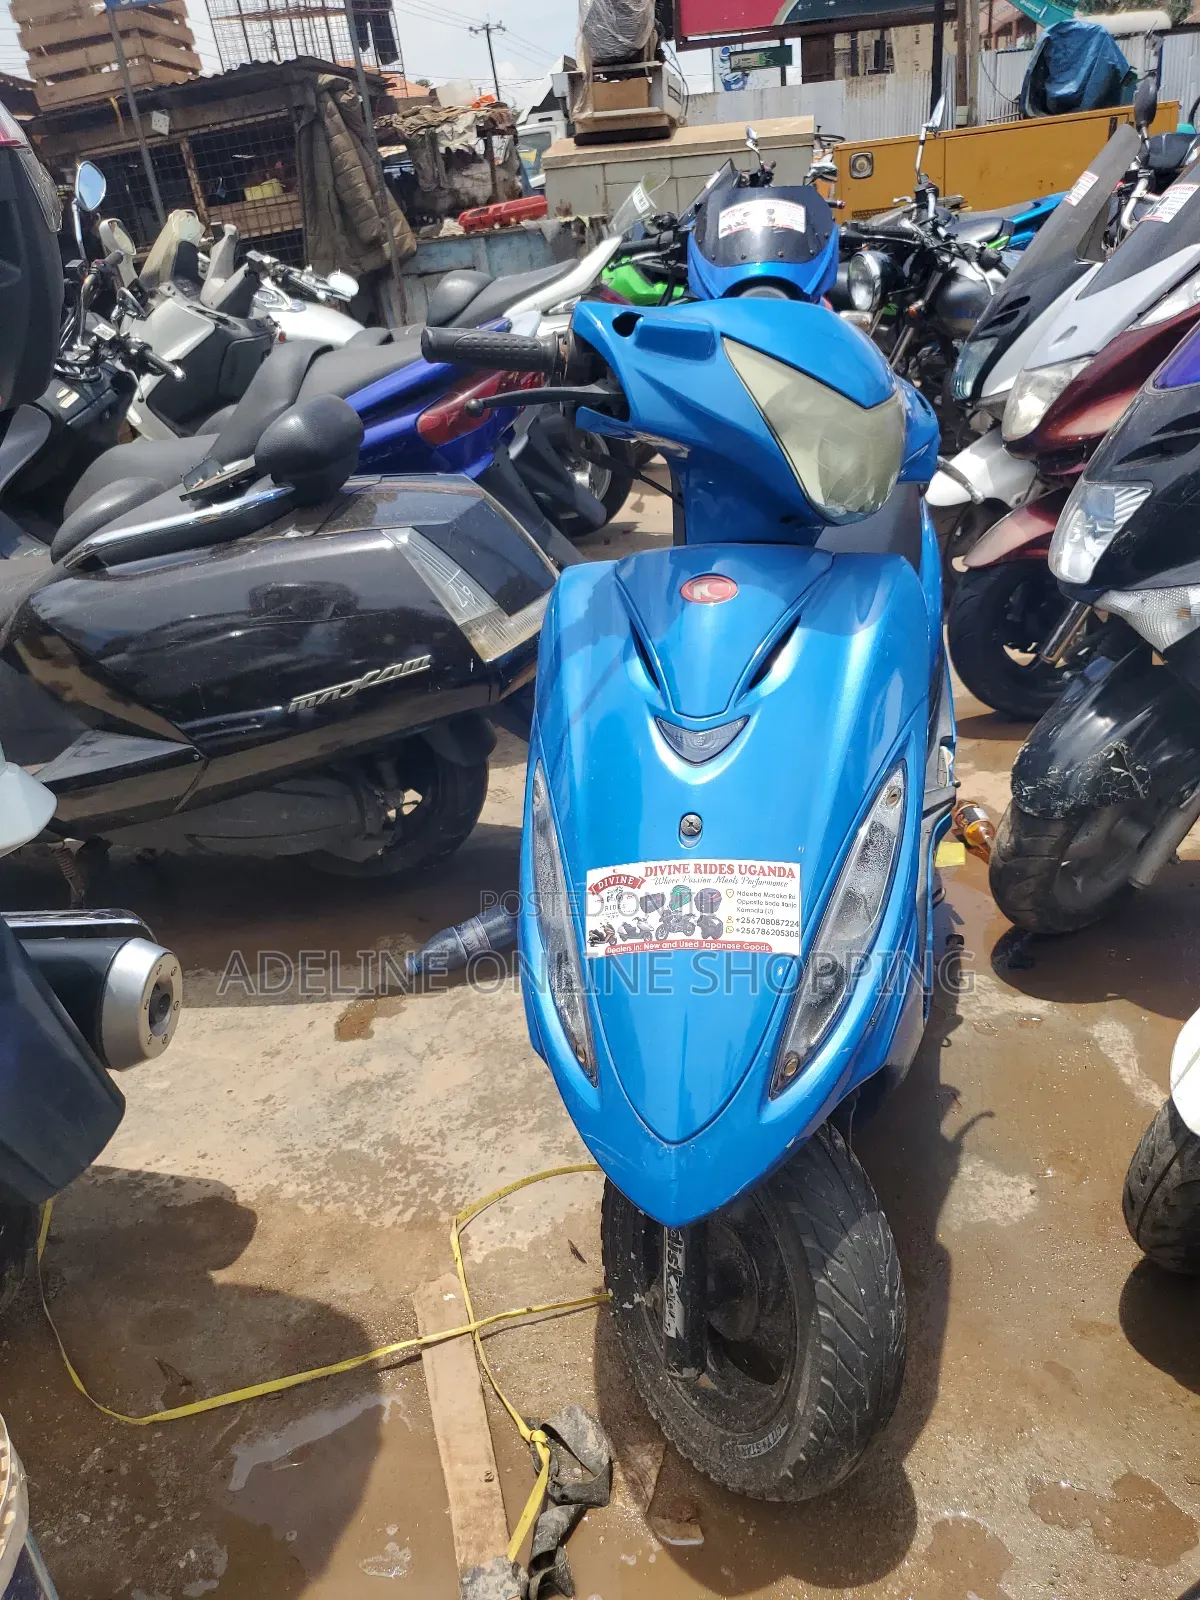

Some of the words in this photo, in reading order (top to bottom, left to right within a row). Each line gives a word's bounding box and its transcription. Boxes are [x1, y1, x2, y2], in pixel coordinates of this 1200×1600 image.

[644, 863, 690, 877] DIVINE
[693, 863, 734, 875] RIDES
[738, 863, 796, 879] UGANDA
[597, 875, 635, 890] DIVINE
[682, 875, 711, 884] Passion
[713, 875, 740, 884] Meets
[735, 916, 799, 928] +256708087224
[606, 945, 633, 954] Dealers
[643, 941, 660, 950] New
[662, 941, 678, 949] and
[679, 940, 698, 949] Used
[701, 940, 741, 950] Japanese
[743, 942, 770, 951] Goods
